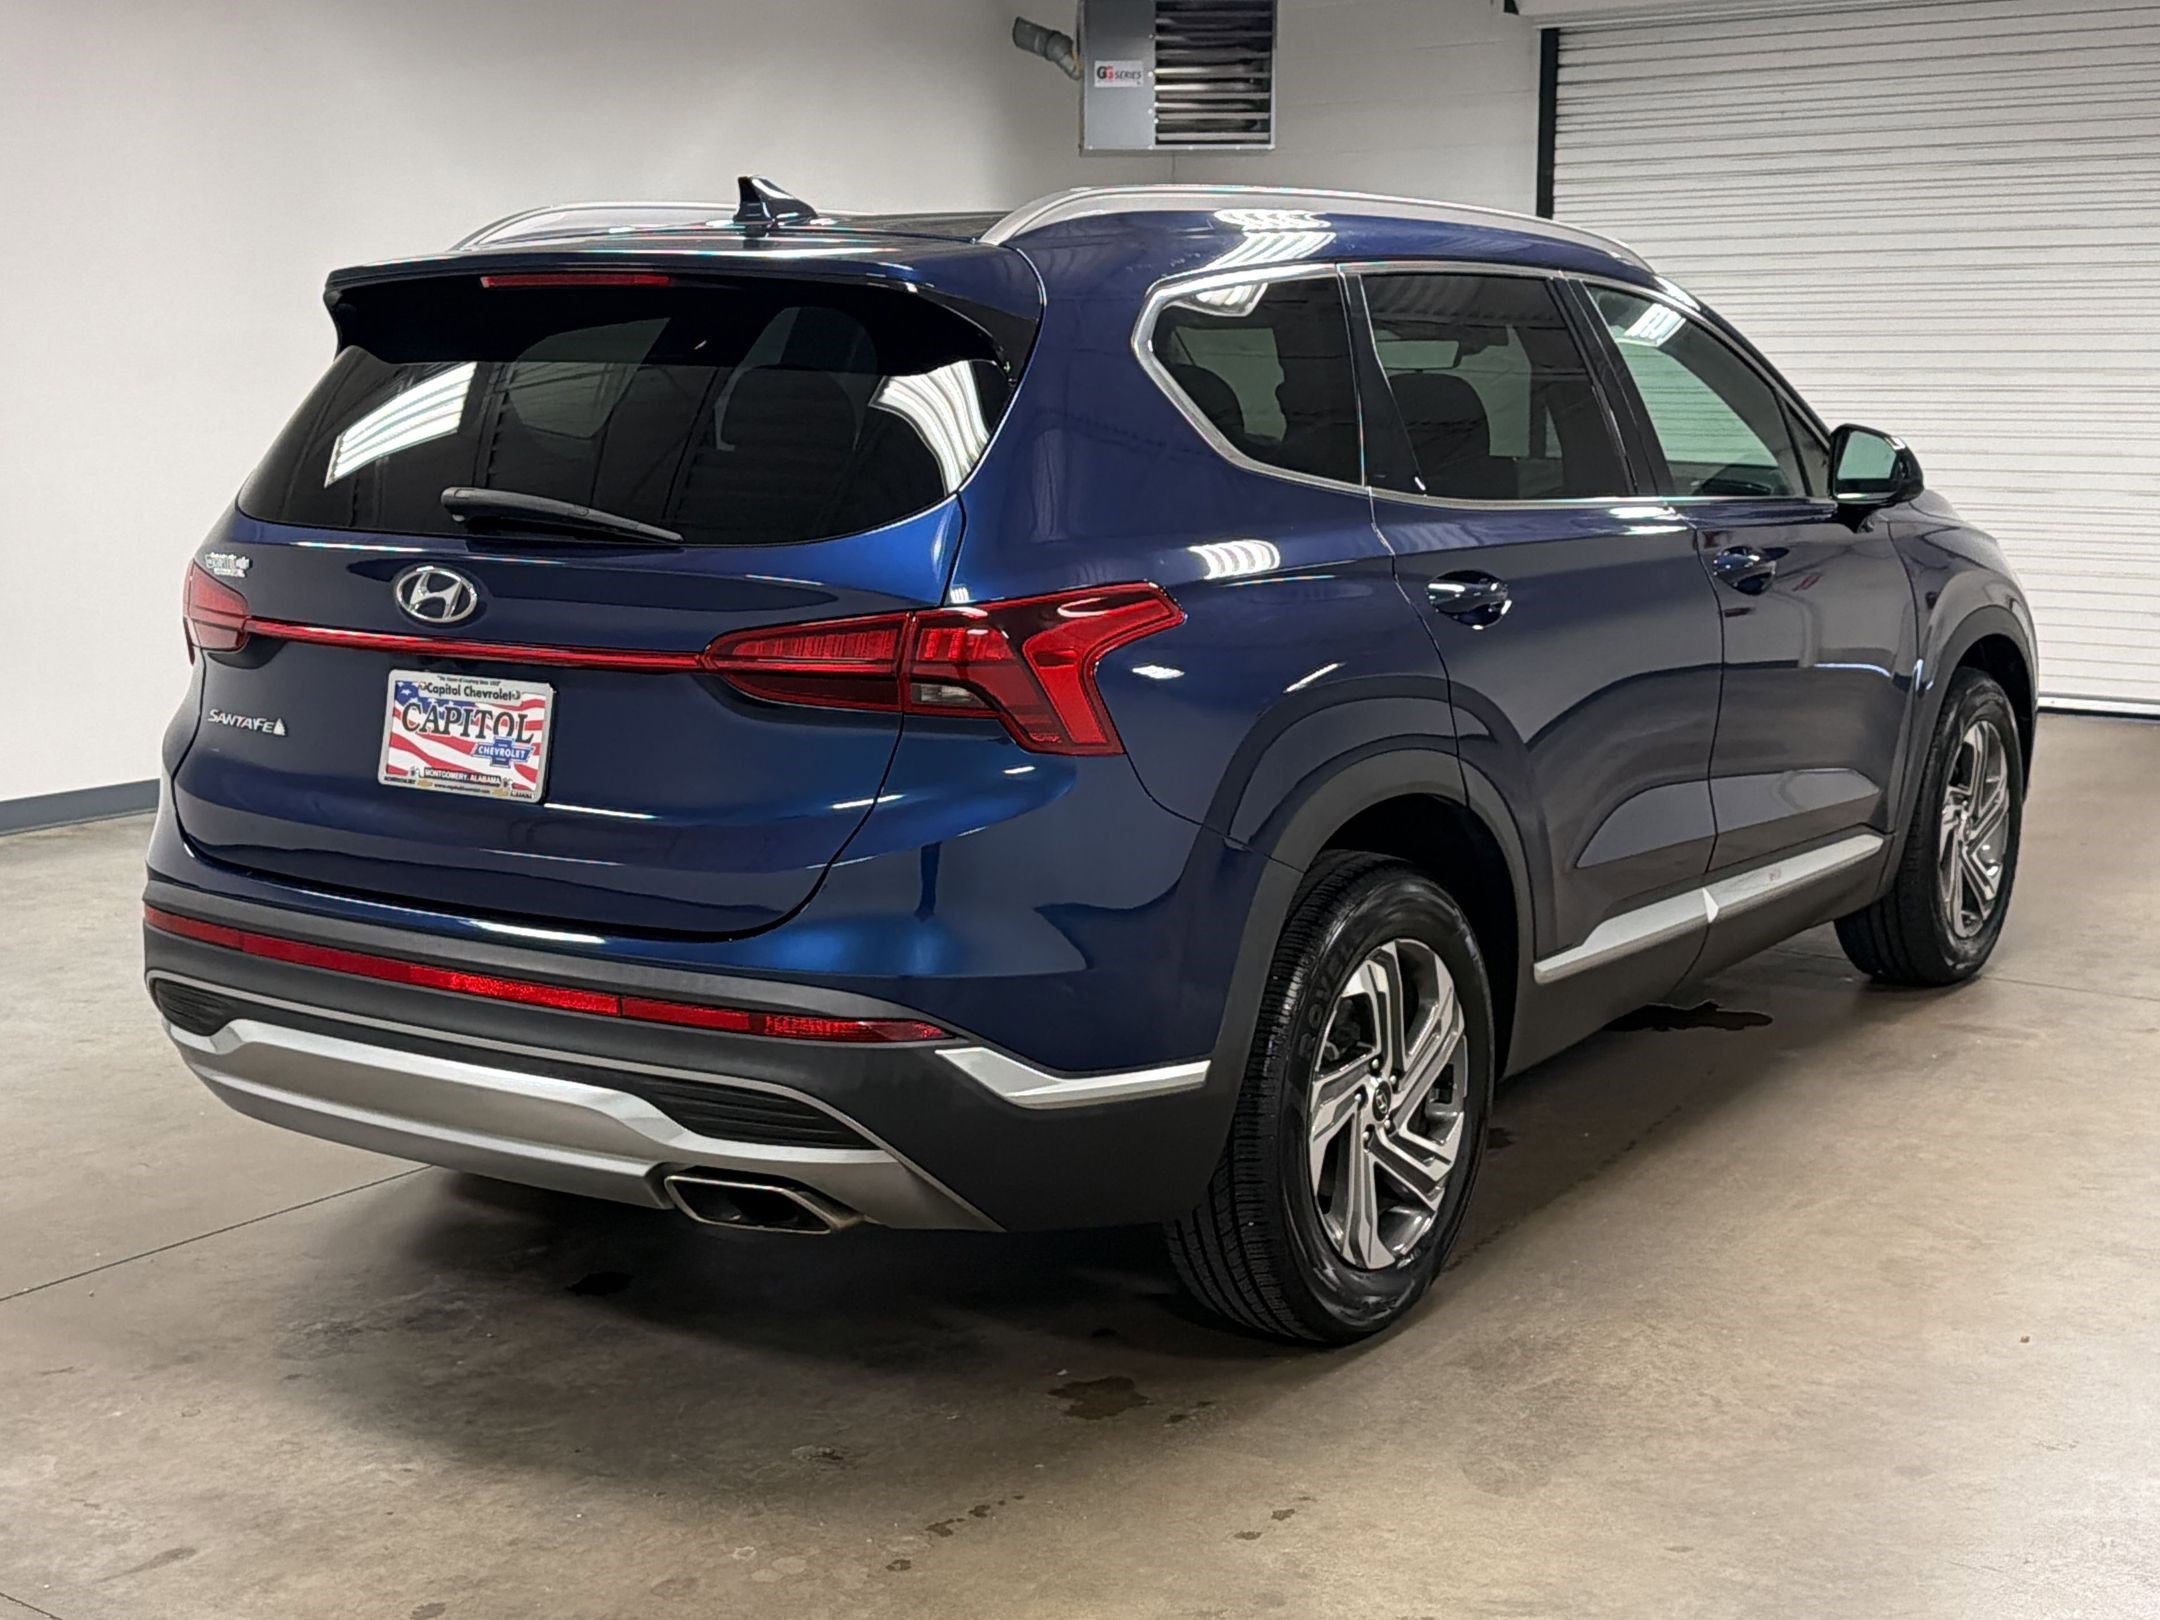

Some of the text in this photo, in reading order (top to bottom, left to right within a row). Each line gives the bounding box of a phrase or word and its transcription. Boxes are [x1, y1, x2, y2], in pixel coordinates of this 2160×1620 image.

[427, 682, 512, 701] Capitol Chevrolet
[401, 702, 535, 744] CAPITOL
[478, 746, 525, 759] CHEVROLET
